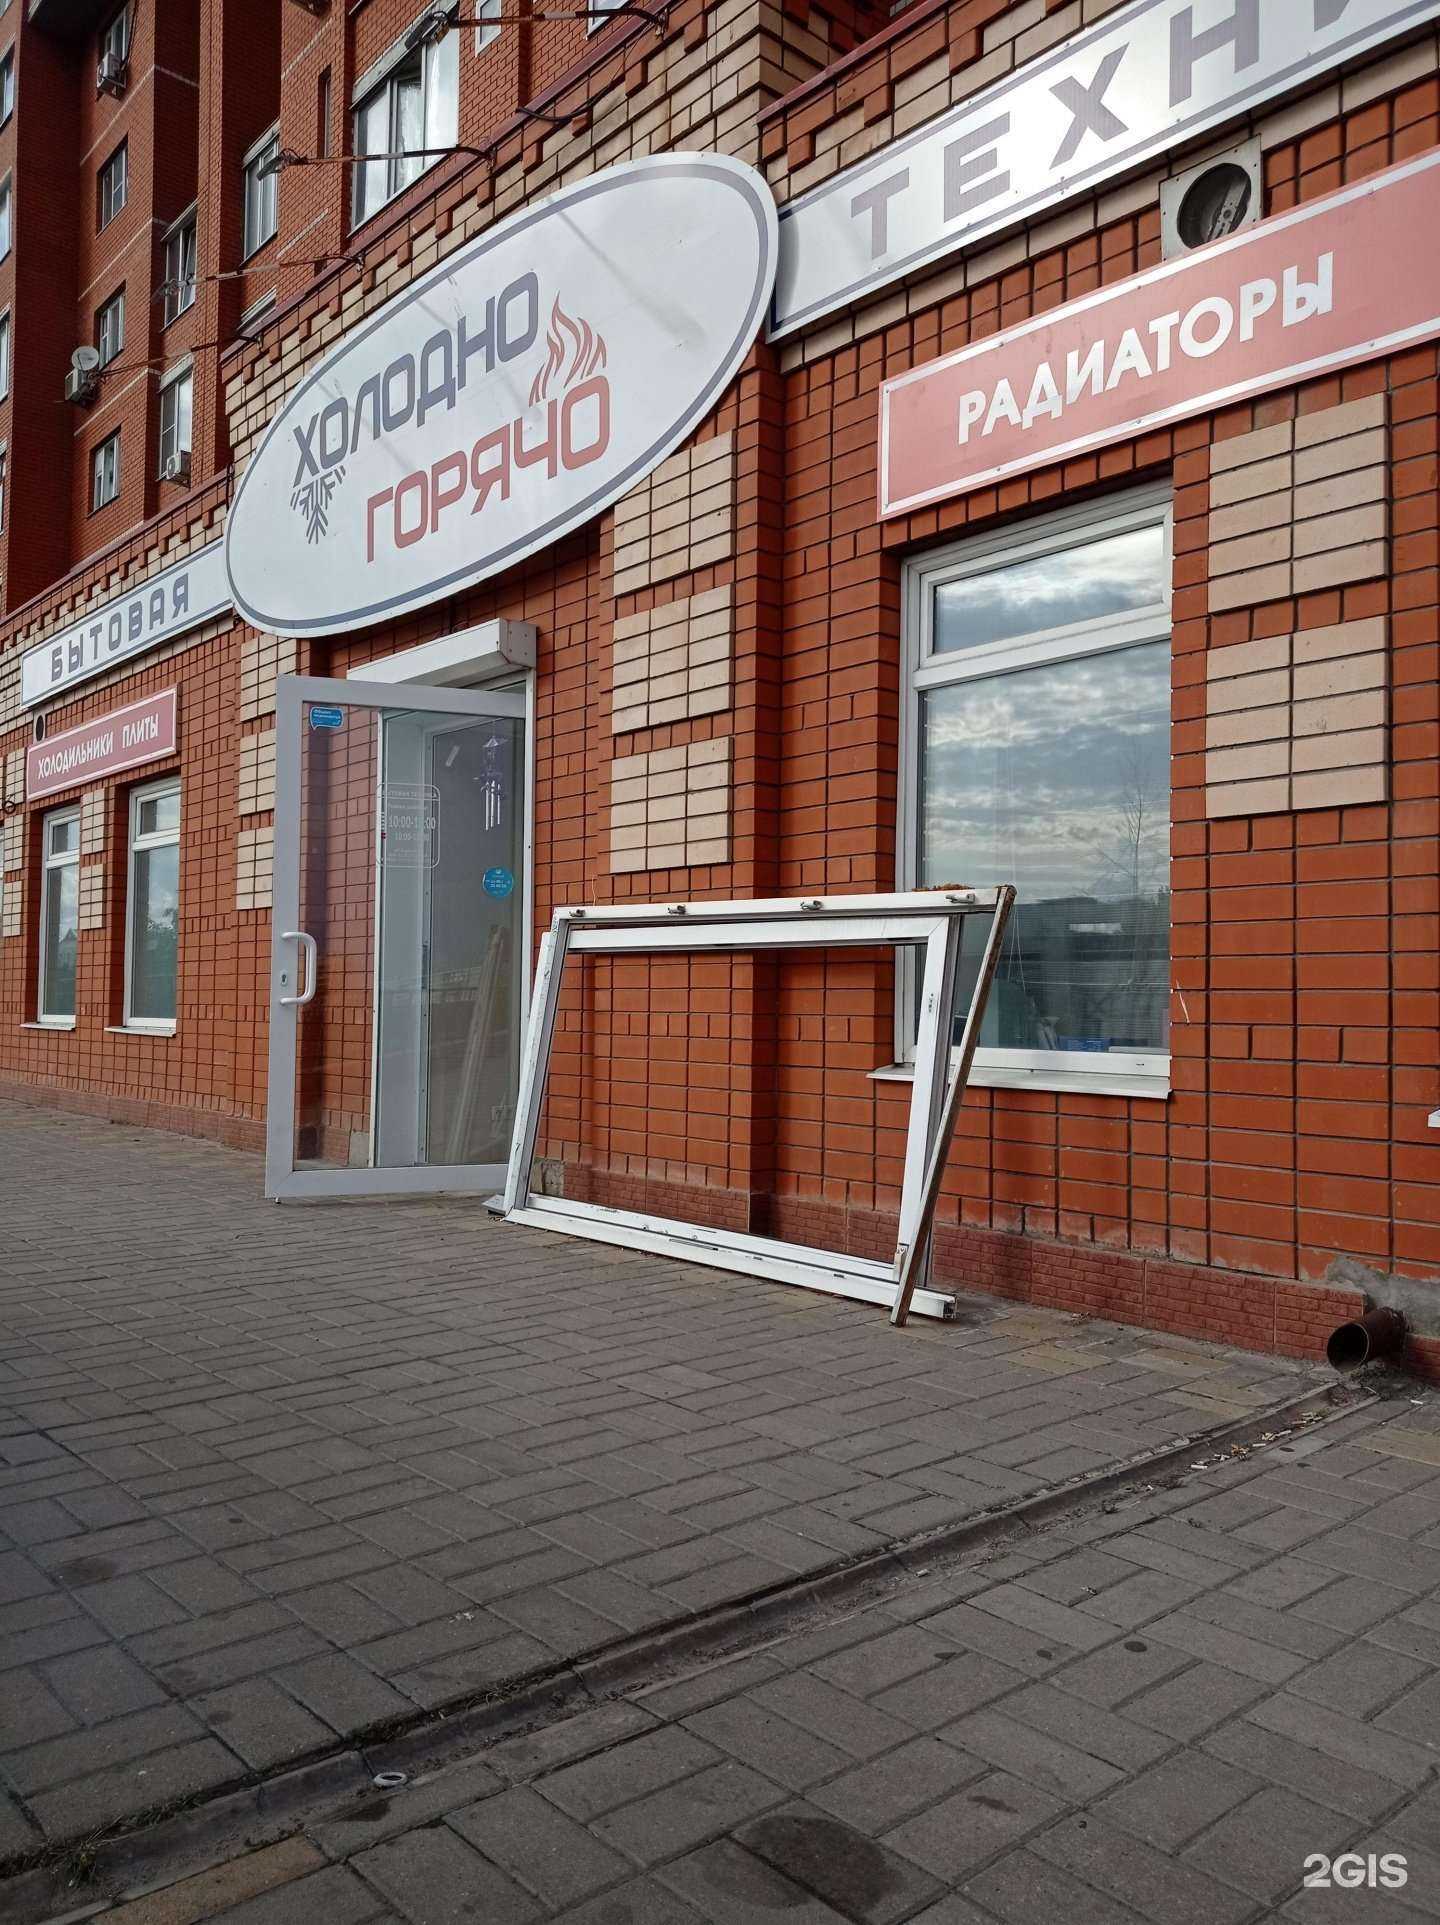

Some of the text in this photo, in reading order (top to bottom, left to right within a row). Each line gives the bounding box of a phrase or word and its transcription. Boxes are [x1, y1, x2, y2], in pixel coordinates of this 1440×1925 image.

[851, 0, 1350, 260] ТЕХН
[292, 271, 539, 487] ХОЛОДНО
[957, 251, 1334, 446] РАДИАТОРЫ
[366, 375, 611, 564] ГОРЯЧО
[51, 572, 189, 682] БЫТОВАЯ
[37, 713, 159, 780] ХОЛОДИЛЬНИКИ ПЛИТЫ
